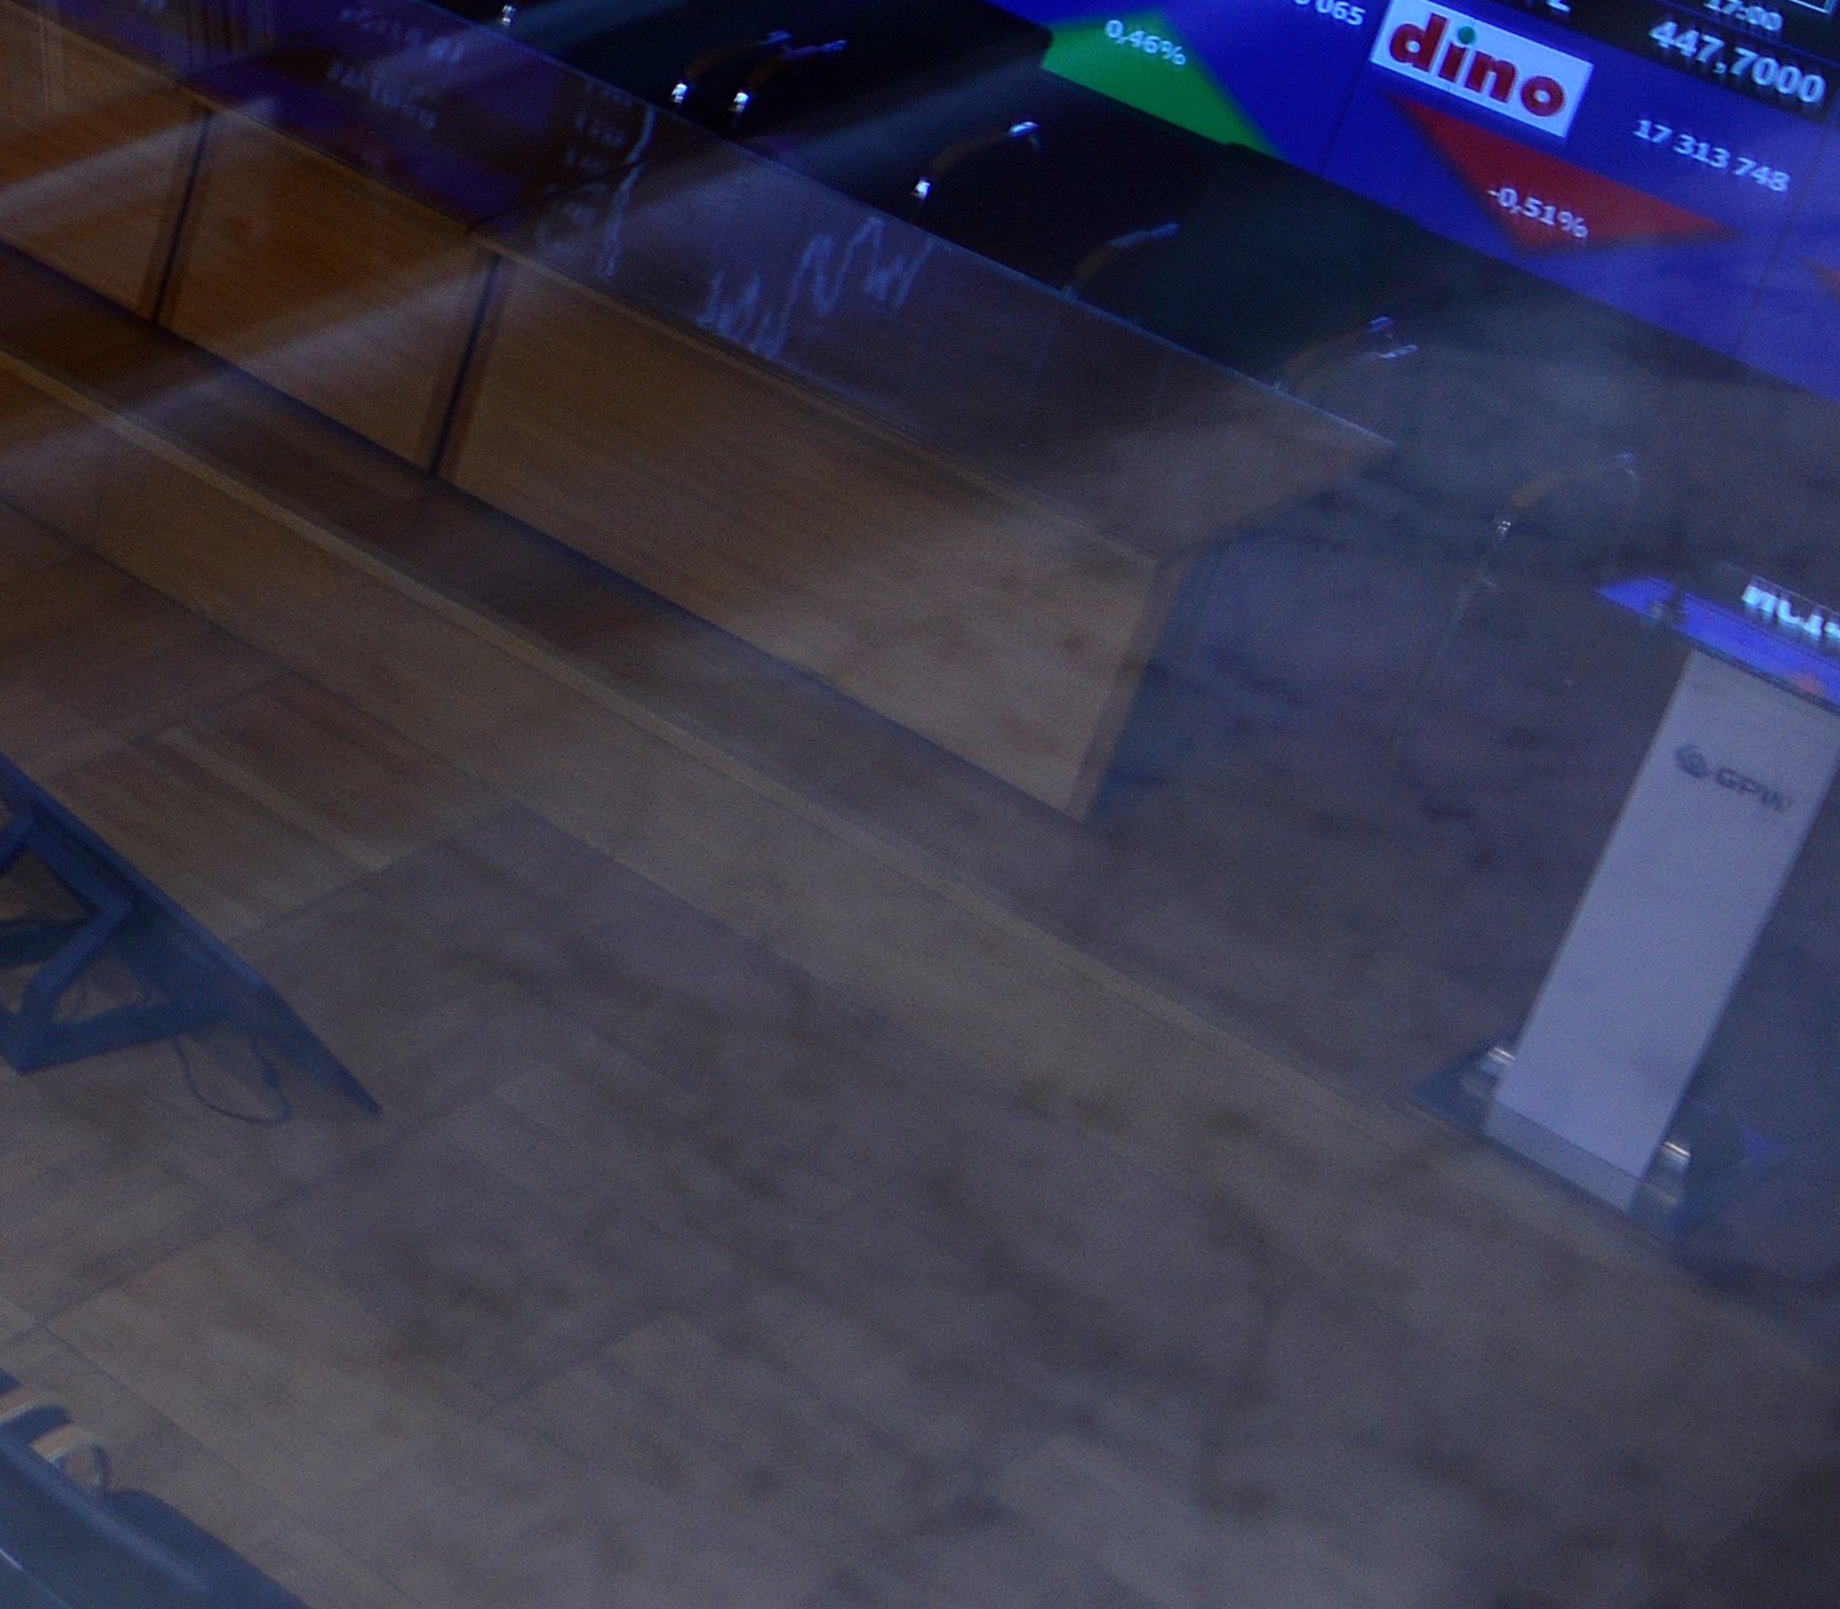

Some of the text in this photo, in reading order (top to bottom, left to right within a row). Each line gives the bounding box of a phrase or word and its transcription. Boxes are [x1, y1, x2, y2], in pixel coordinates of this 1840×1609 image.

[1104, 19, 1188, 67] 0,46%
[1389, 13, 1566, 117] dino
[1648, 20, 1827, 104] 447,7000
[1633, 118, 1791, 193] 17 313 748
[1487, 187, 1589, 240] -0,51%
